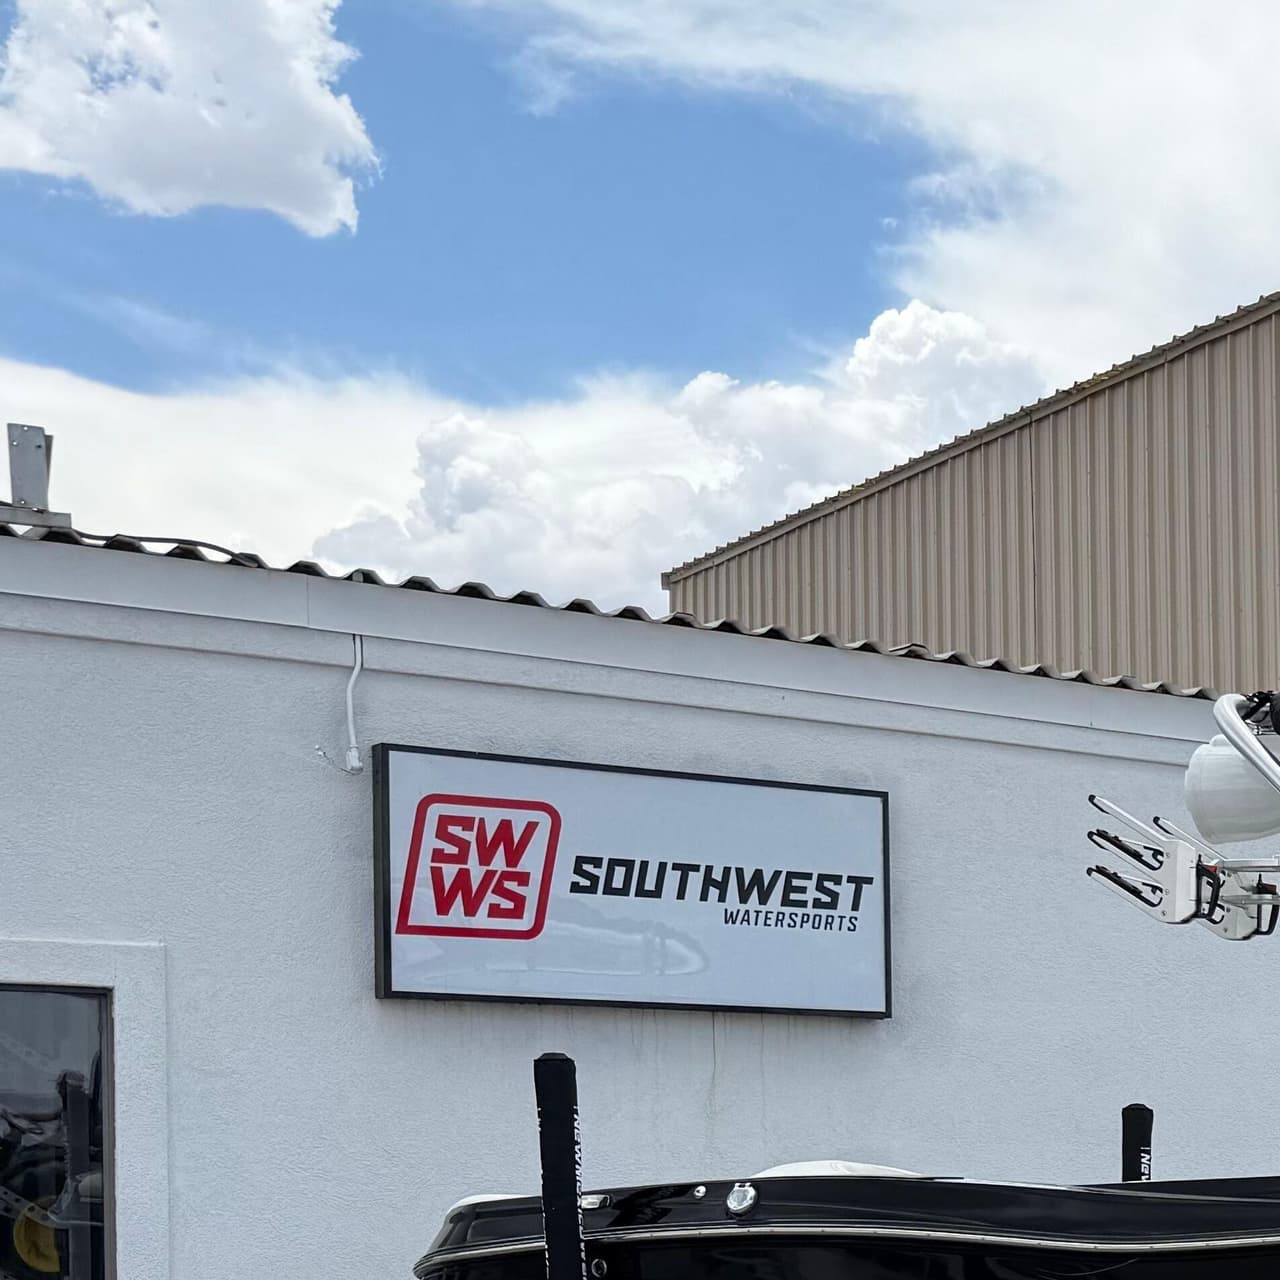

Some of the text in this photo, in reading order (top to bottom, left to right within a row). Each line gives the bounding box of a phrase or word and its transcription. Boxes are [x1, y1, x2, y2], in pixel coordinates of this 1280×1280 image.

[431, 814, 540, 868] SW
[430, 866, 531, 919] WS
[569, 855, 874, 911] SOUTHWEST
[724, 907, 858, 932] WATERSPORTS
